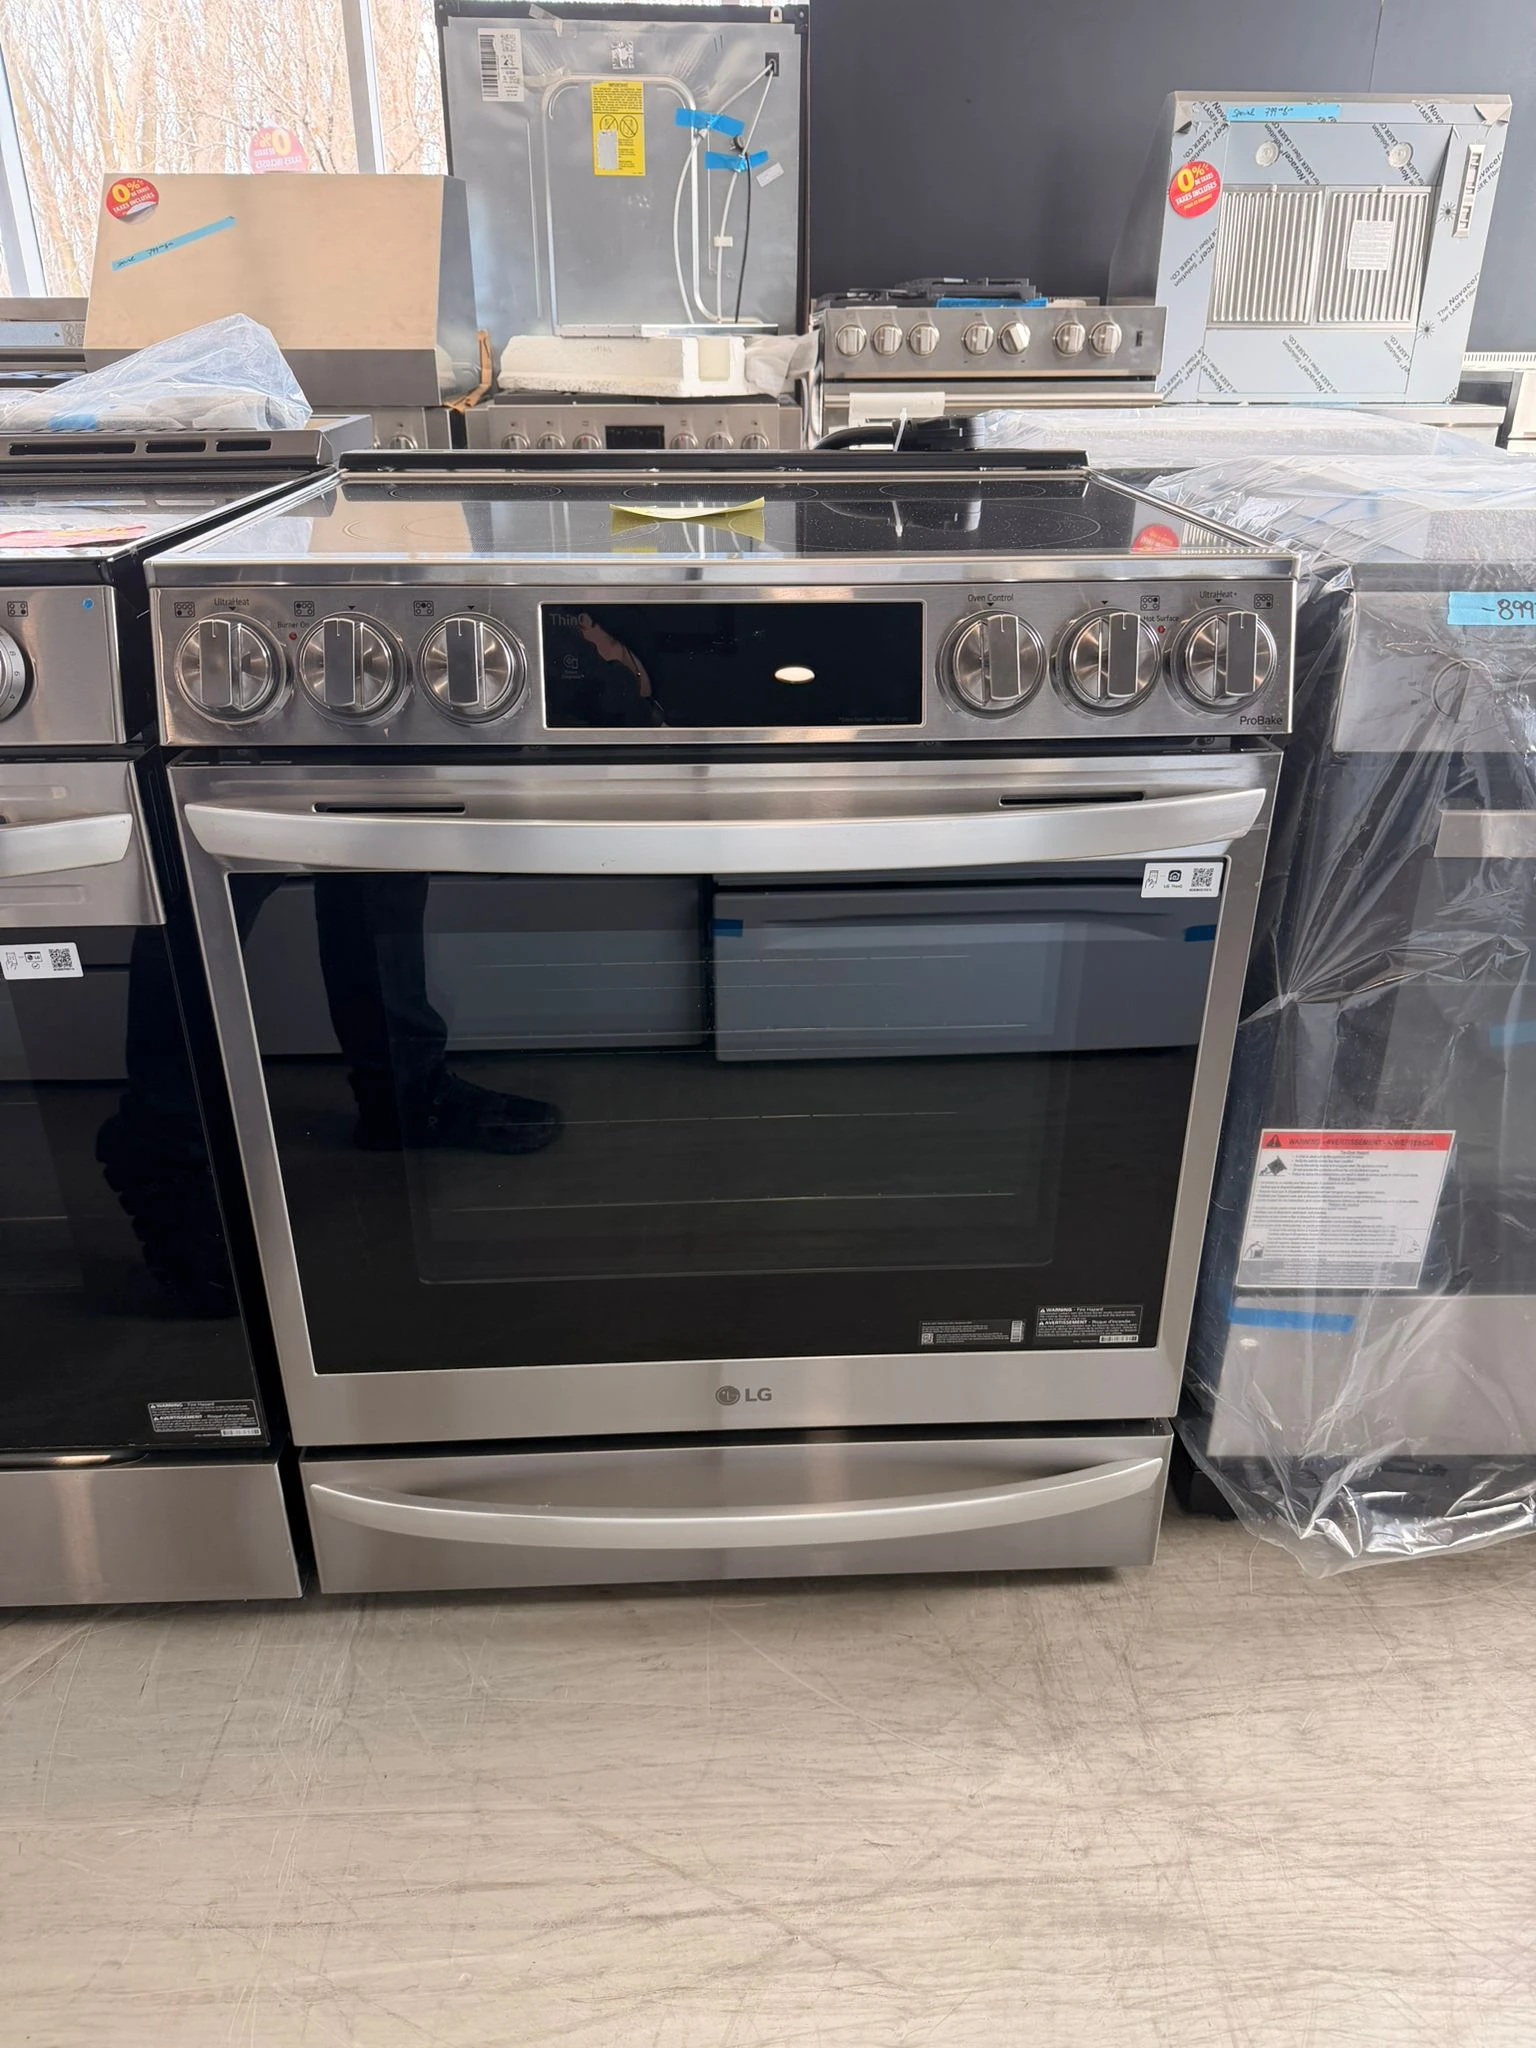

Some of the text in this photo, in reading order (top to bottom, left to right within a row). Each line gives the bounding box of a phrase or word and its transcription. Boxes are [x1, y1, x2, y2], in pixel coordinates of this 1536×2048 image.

[1278, 128, 1292, 146] LASER
[1300, 161, 1315, 179] LASER
[1175, 192, 1193, 206] TAXES
[1192, 180, 1217, 198] INCLUSES
[113, 203, 130, 213] TAXES
[129, 192, 155, 206] INCLUSES
[1180, 253, 1196, 271] LASER
[1437, 304, 1449, 317] The
[1449, 298, 1466, 316] LASER
[214, 598, 250, 607] UltraHeat
[968, 593, 1014, 602] Oven Control
[277, 621, 311, 629] Burner On
[1156, 614, 1180, 622] Surface
[1239, 715, 1283, 726] ProBake
[744, 1388, 772, 1402] LG
